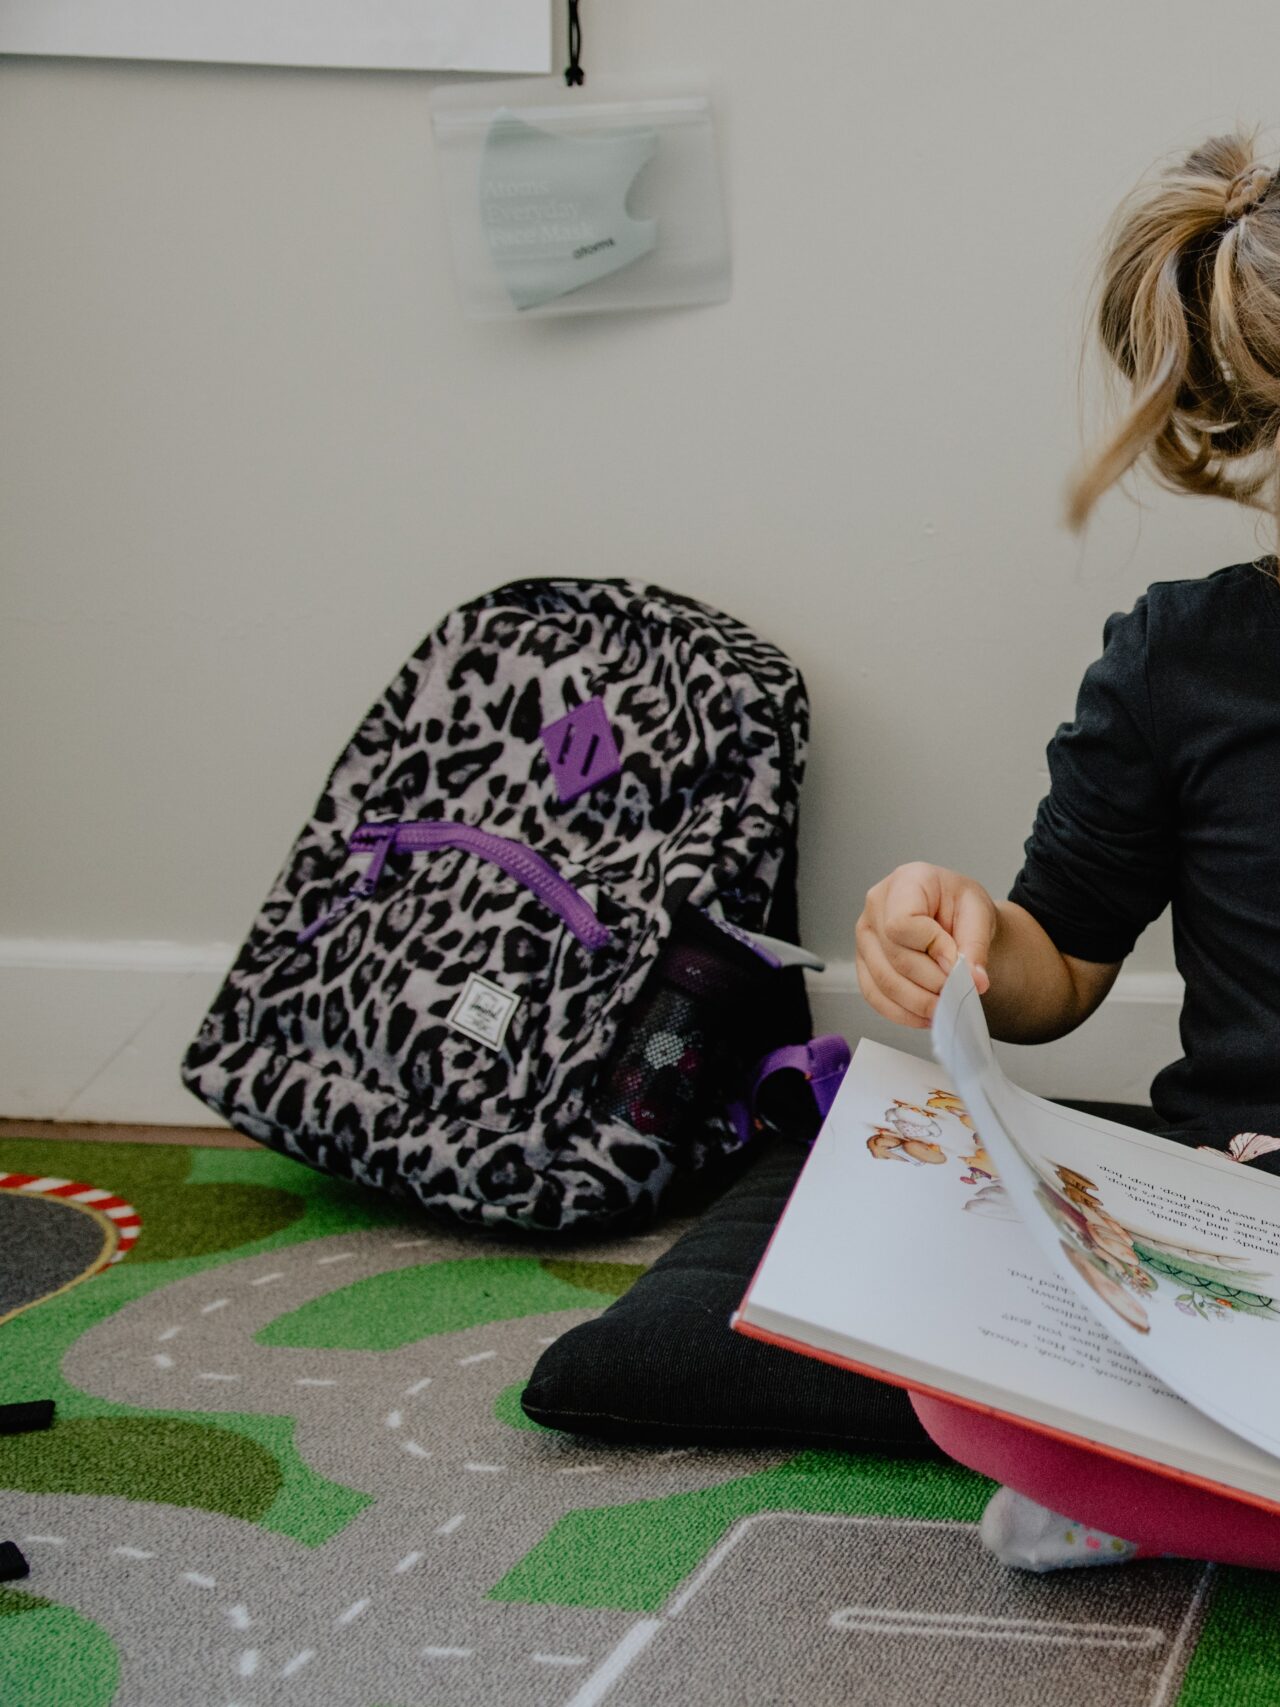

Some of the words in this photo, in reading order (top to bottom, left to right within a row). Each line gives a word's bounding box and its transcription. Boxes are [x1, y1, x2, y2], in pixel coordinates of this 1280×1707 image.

[1189, 1196, 1220, 1212] went
[1166, 1204, 1202, 1224] sugar
[1193, 1206, 1214, 1220] the
[1218, 1215, 1230, 1224] at
[1224, 1208, 1255, 1224] away
[1203, 1218, 1229, 1234] and
[1234, 1220, 1268, 1234] some
[1233, 1226, 1262, 1244] cake
